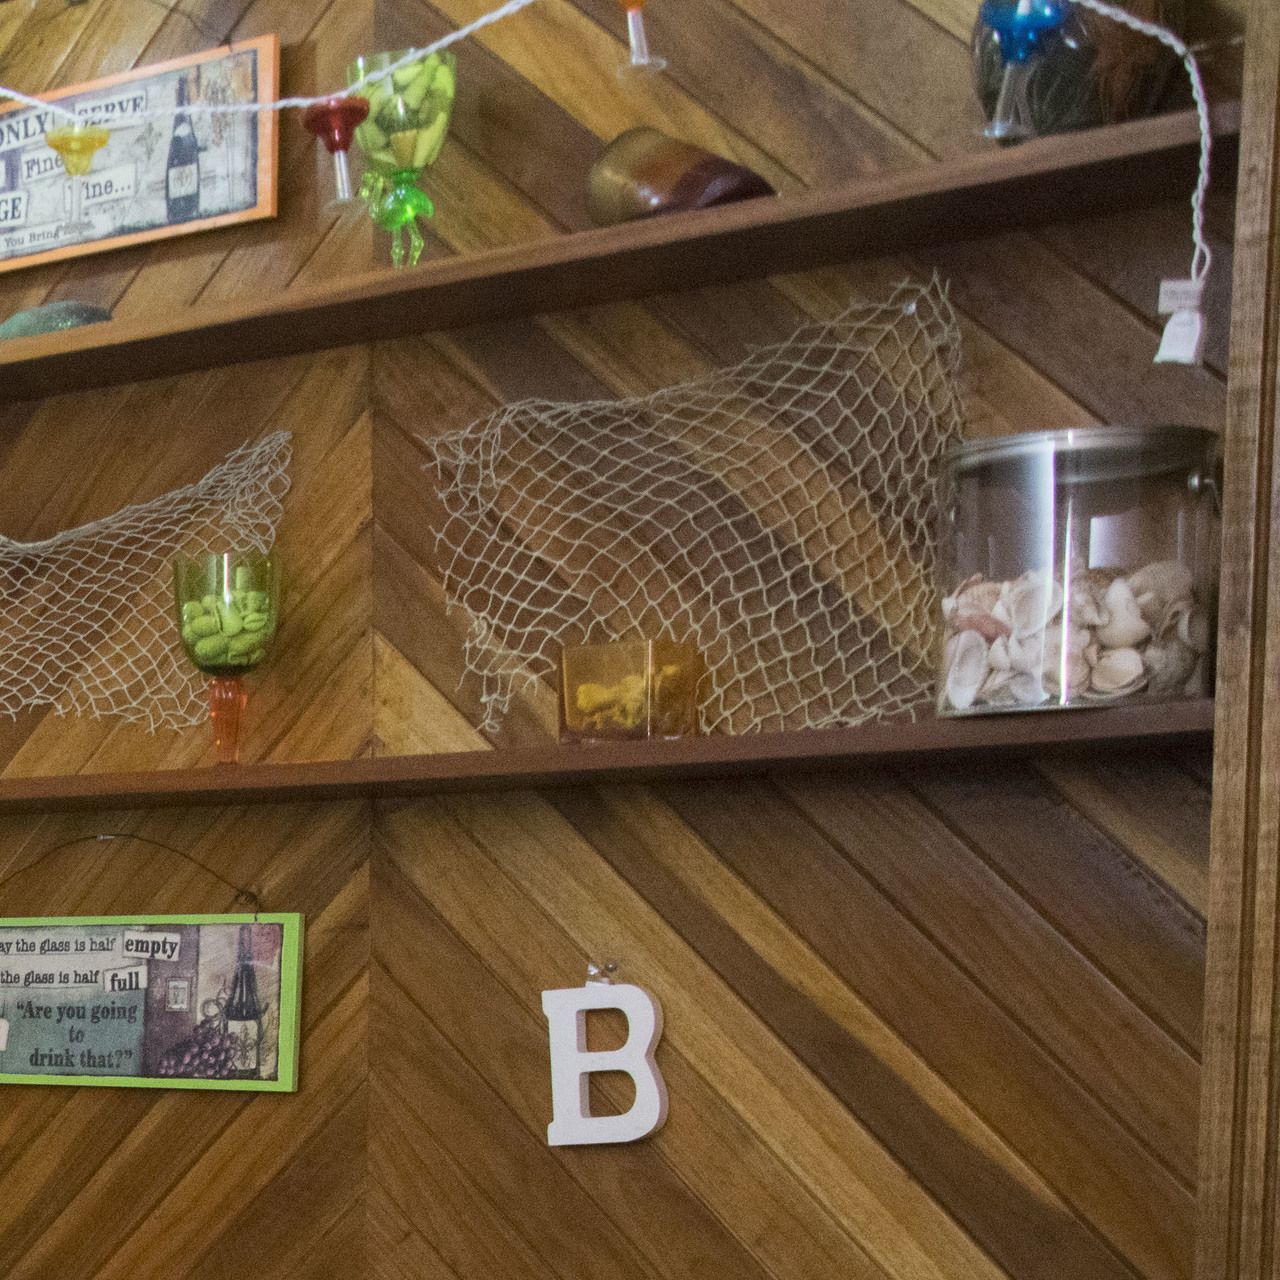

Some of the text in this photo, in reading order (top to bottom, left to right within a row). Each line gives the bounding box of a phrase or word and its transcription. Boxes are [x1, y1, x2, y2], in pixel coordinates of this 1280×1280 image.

[24, 153, 64, 179] Fine
[68, 180, 131, 200] ine...
[4, 237, 25, 249] You
[15, 938, 36, 953] the
[40, 938, 70, 954] glass
[74, 938, 86, 952] is
[90, 938, 117, 952] half
[125, 936, 179, 959] empty
[0, 970, 20, 984] the
[24, 970, 55, 987] glass
[58, 970, 69, 983] is
[73, 969, 100, 983] half
[110, 972, 140, 992] full
[56, 1005, 86, 1023] you
[91, 1001, 138, 1023] going
[68, 1025, 85, 1043] to
[29, 1047, 75, 1068] drink
[541, 982, 668, 1146] B
